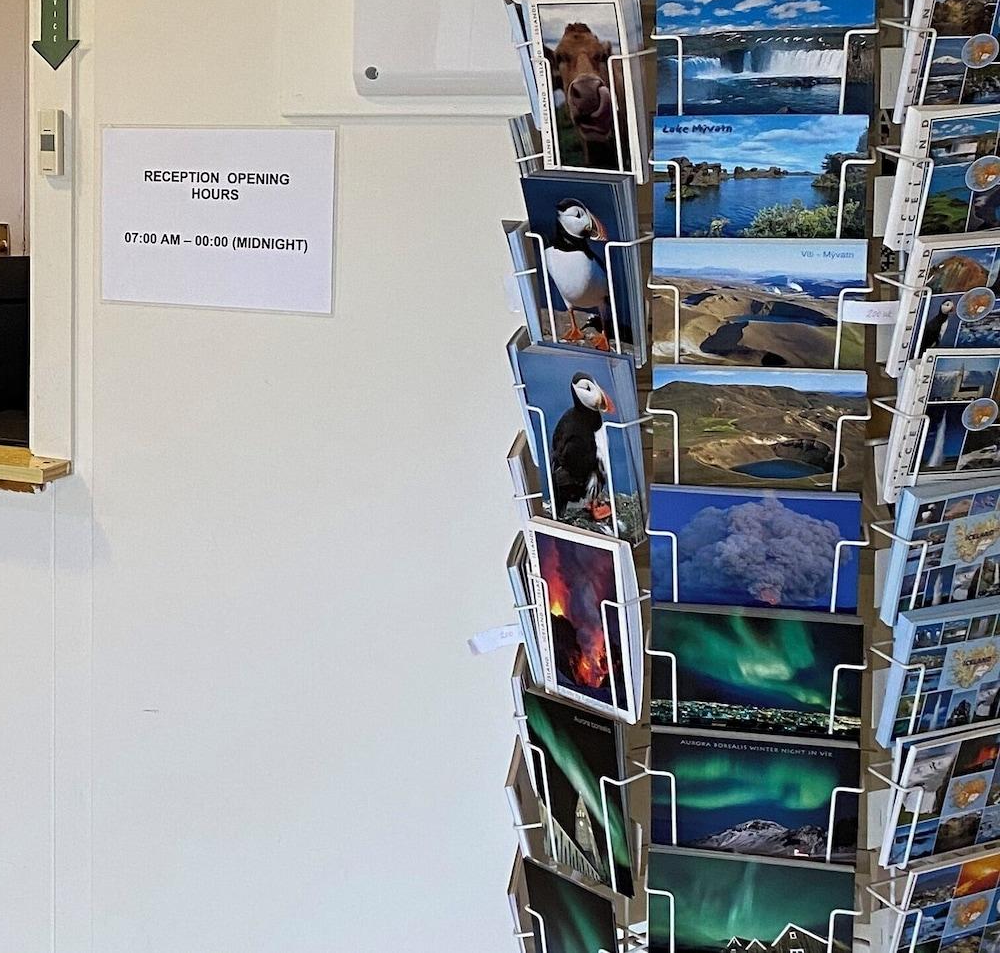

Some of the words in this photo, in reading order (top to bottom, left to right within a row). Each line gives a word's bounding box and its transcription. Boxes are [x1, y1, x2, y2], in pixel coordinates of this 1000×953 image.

[662, 124, 689, 134] Lake
[143, 170, 220, 184] RECEPTION
[227, 172, 290, 186] OPENING
[905, 120, 930, 236] ICELAND
[191, 188, 239, 201] HOURS
[124, 232, 157, 245] 07:00
[161, 234, 181, 246] AM
[195, 235, 228, 248] 00:00
[232, 237, 308, 254] (MIDNIGHT)
[900, 355, 934, 469] ICEAND
[680, 739, 711, 747] AURORA
[713, 742, 748, 750] BOREALIS
[750, 745, 779, 753] WINTER
